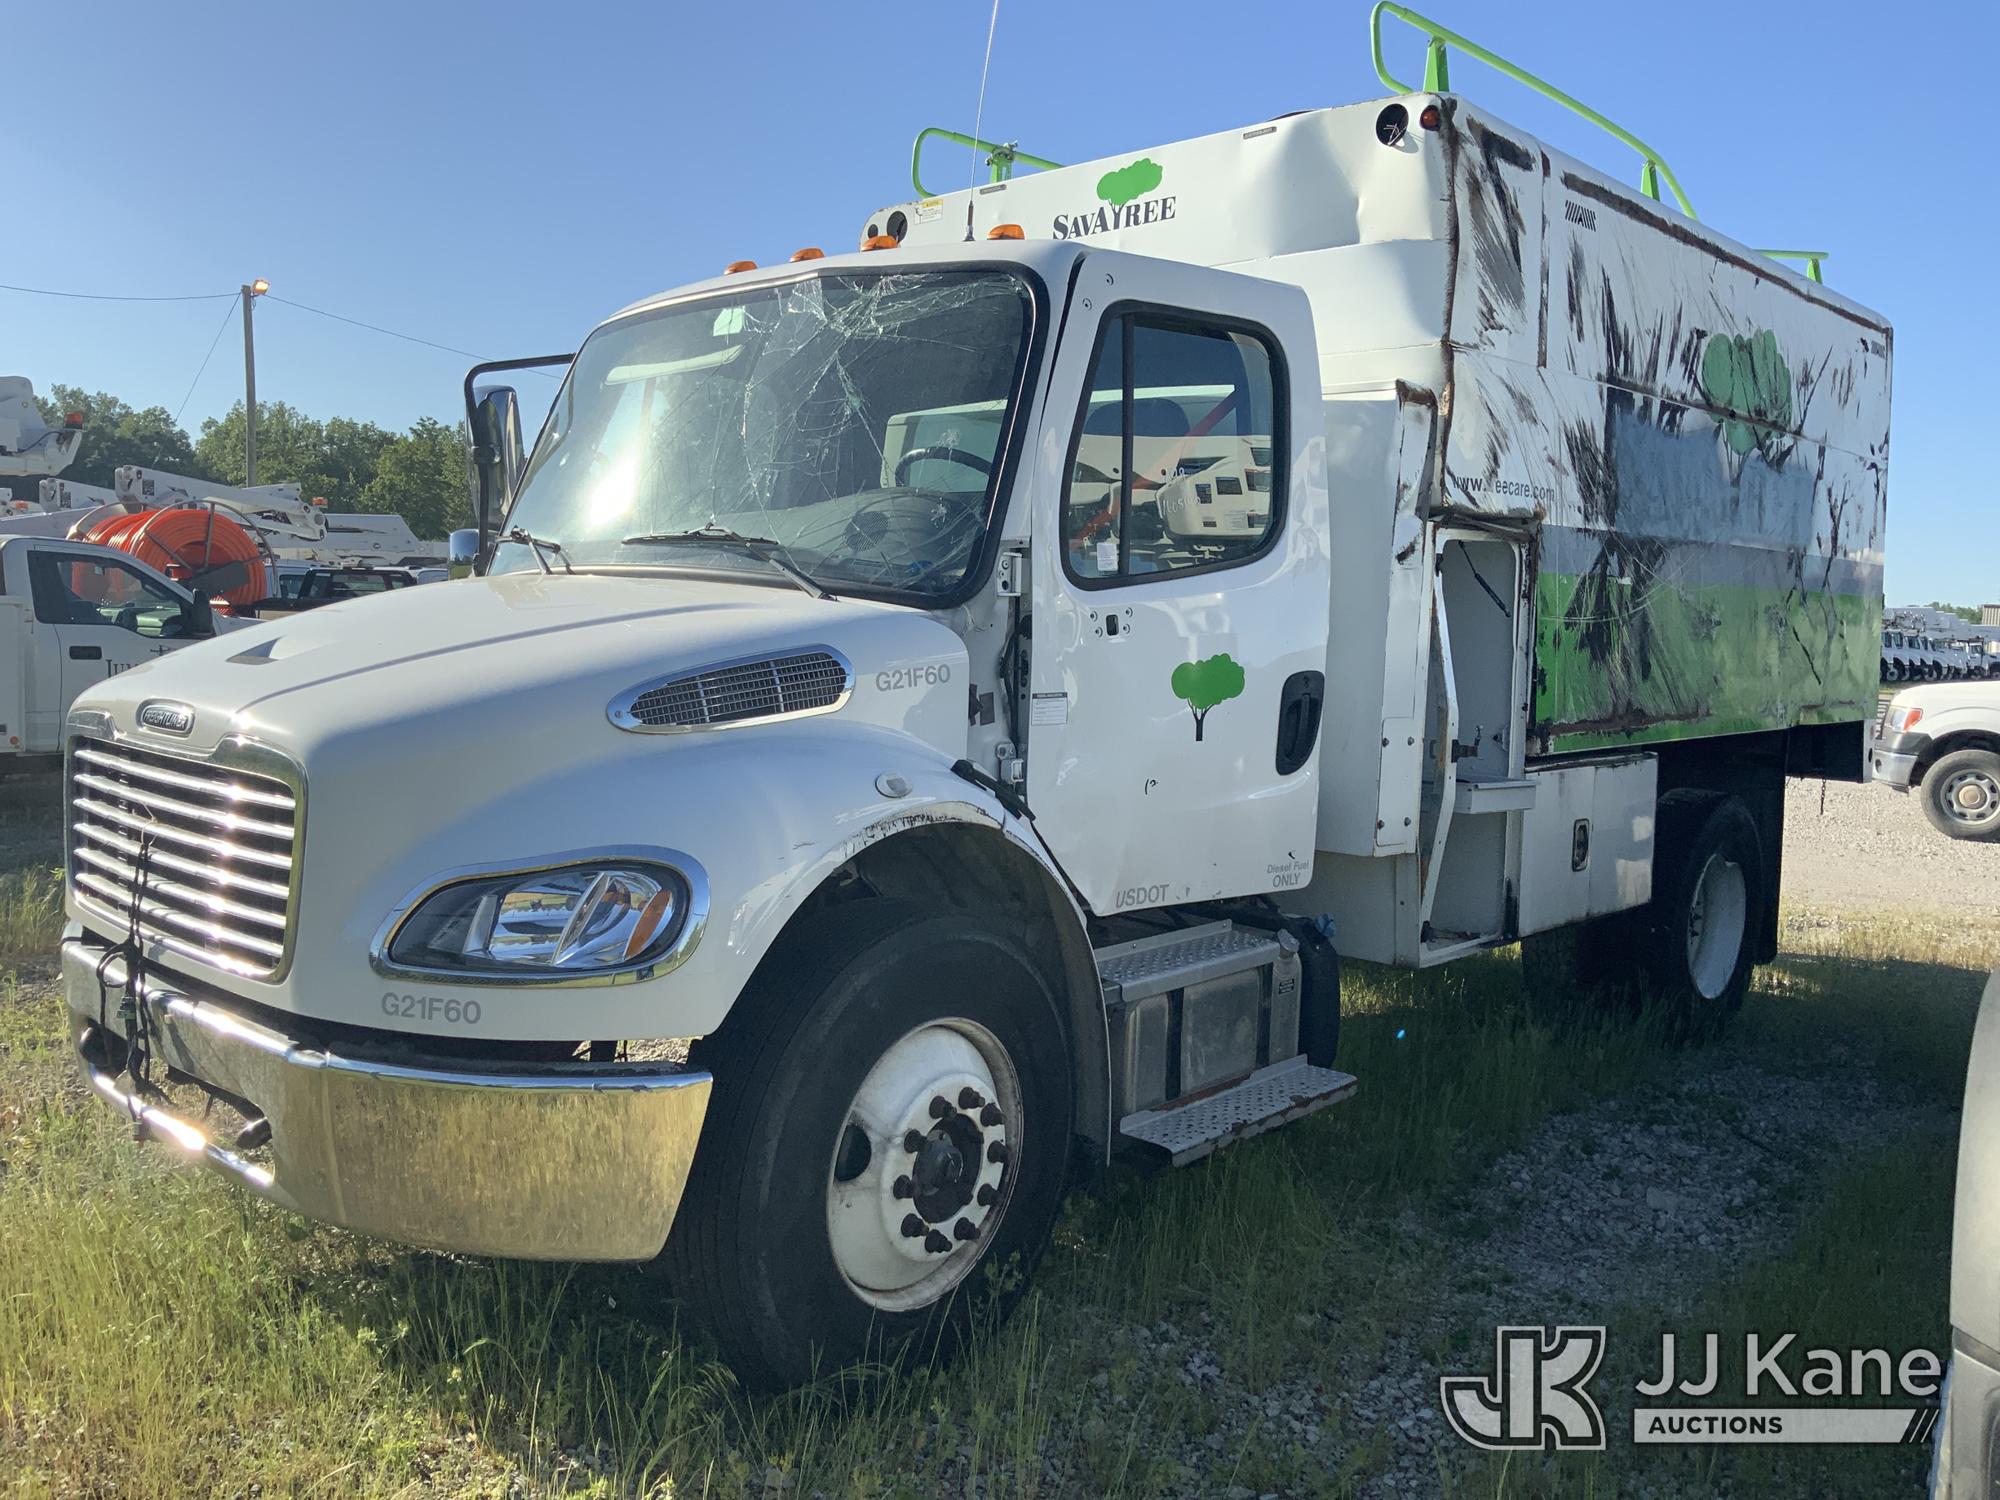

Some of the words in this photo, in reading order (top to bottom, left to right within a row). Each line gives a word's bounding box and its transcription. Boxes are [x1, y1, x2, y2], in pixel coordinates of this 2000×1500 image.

[875, 663, 951, 692] G21F60
[1272, 872, 1301, 888] ONLY
[1115, 884, 1170, 909] USDOT
[381, 991, 482, 1025] G21F60
